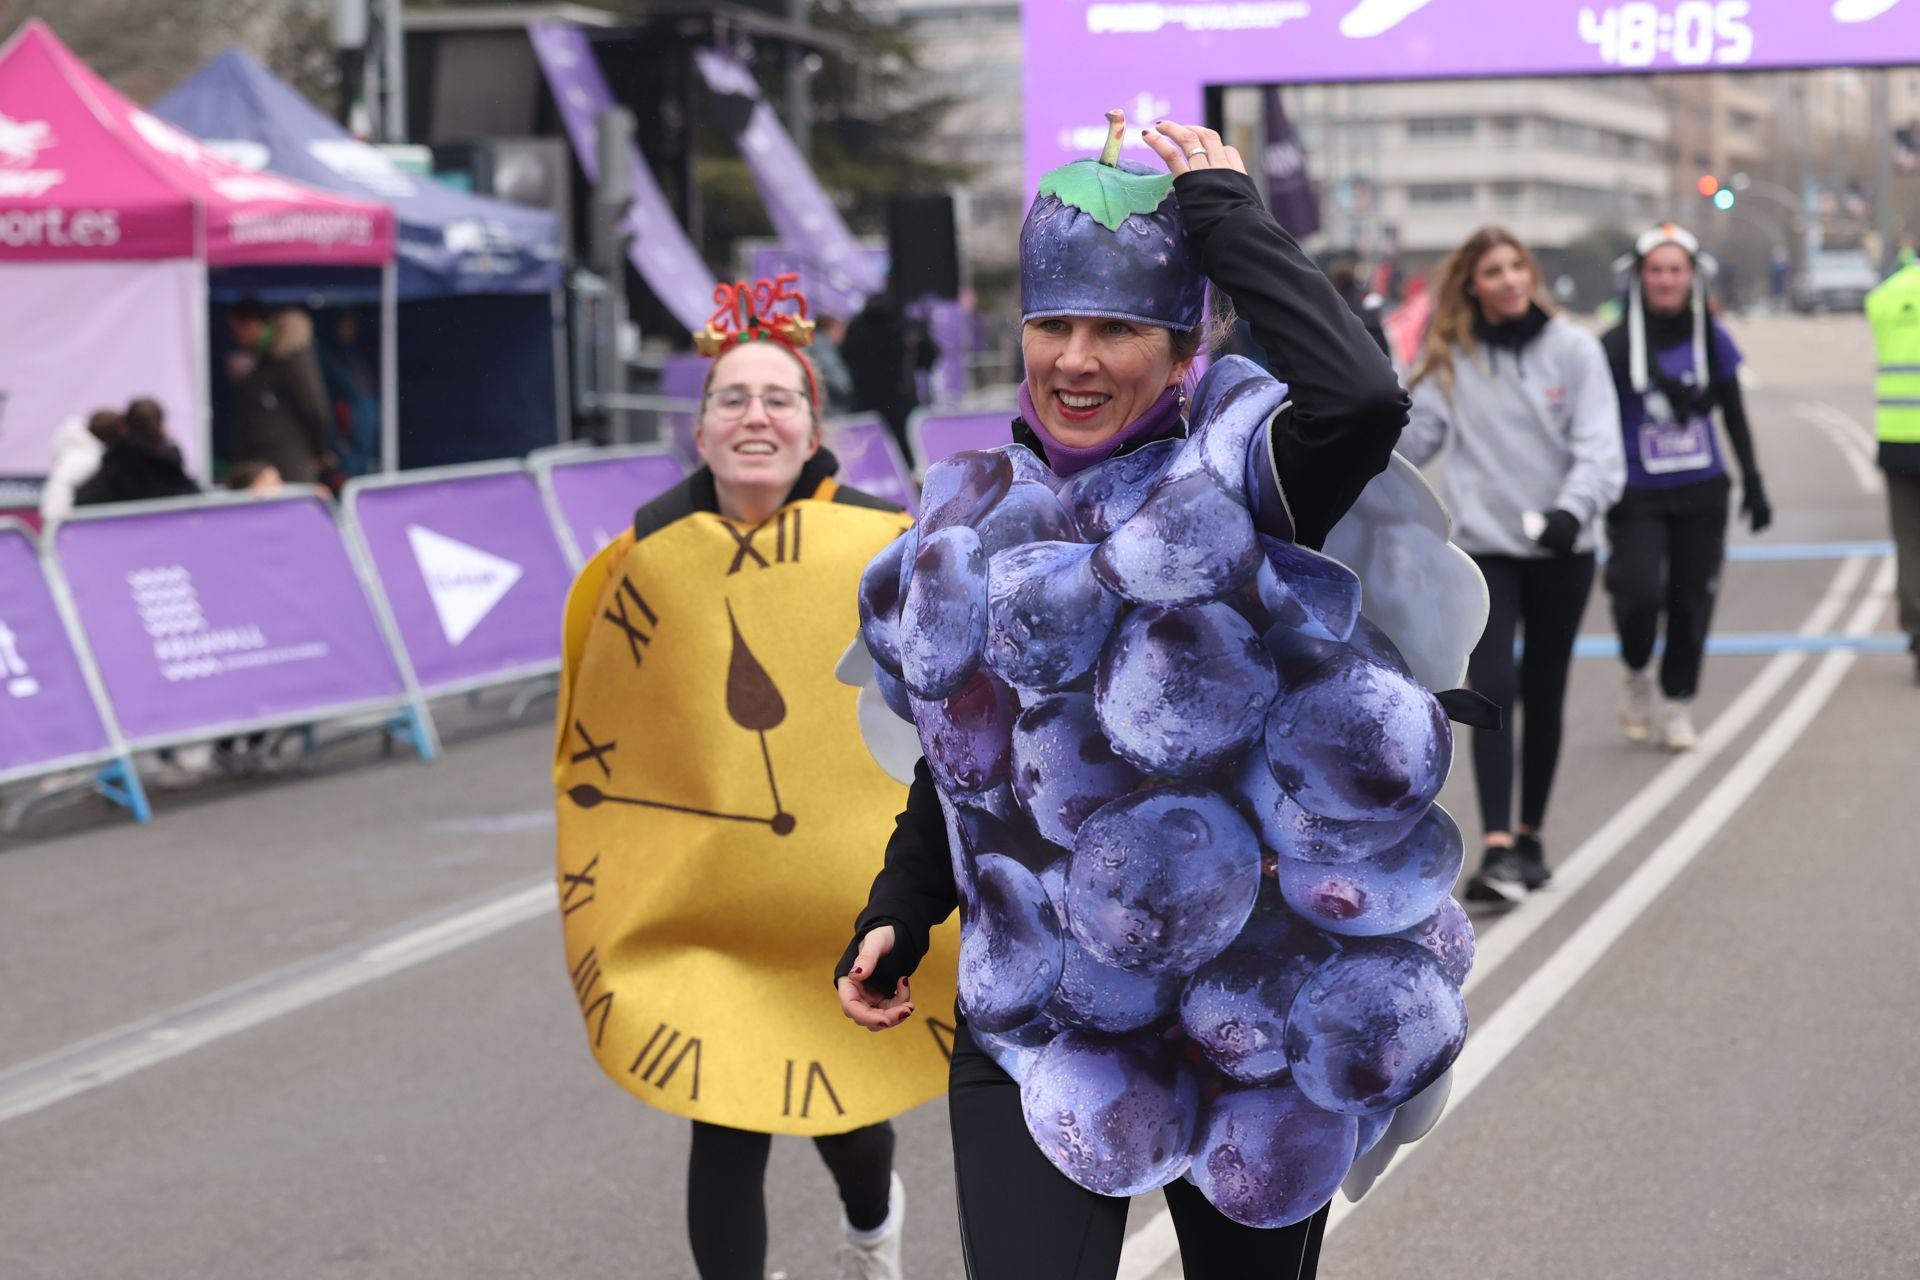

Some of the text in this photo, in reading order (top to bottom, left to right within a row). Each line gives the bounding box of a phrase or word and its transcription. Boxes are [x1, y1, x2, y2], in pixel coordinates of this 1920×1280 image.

[1578, 1, 1754, 66] 48:05
[713, 275, 806, 330] 2025
[719, 508, 802, 576] XII
[604, 576, 659, 667] XI
[571, 720, 616, 780] X
